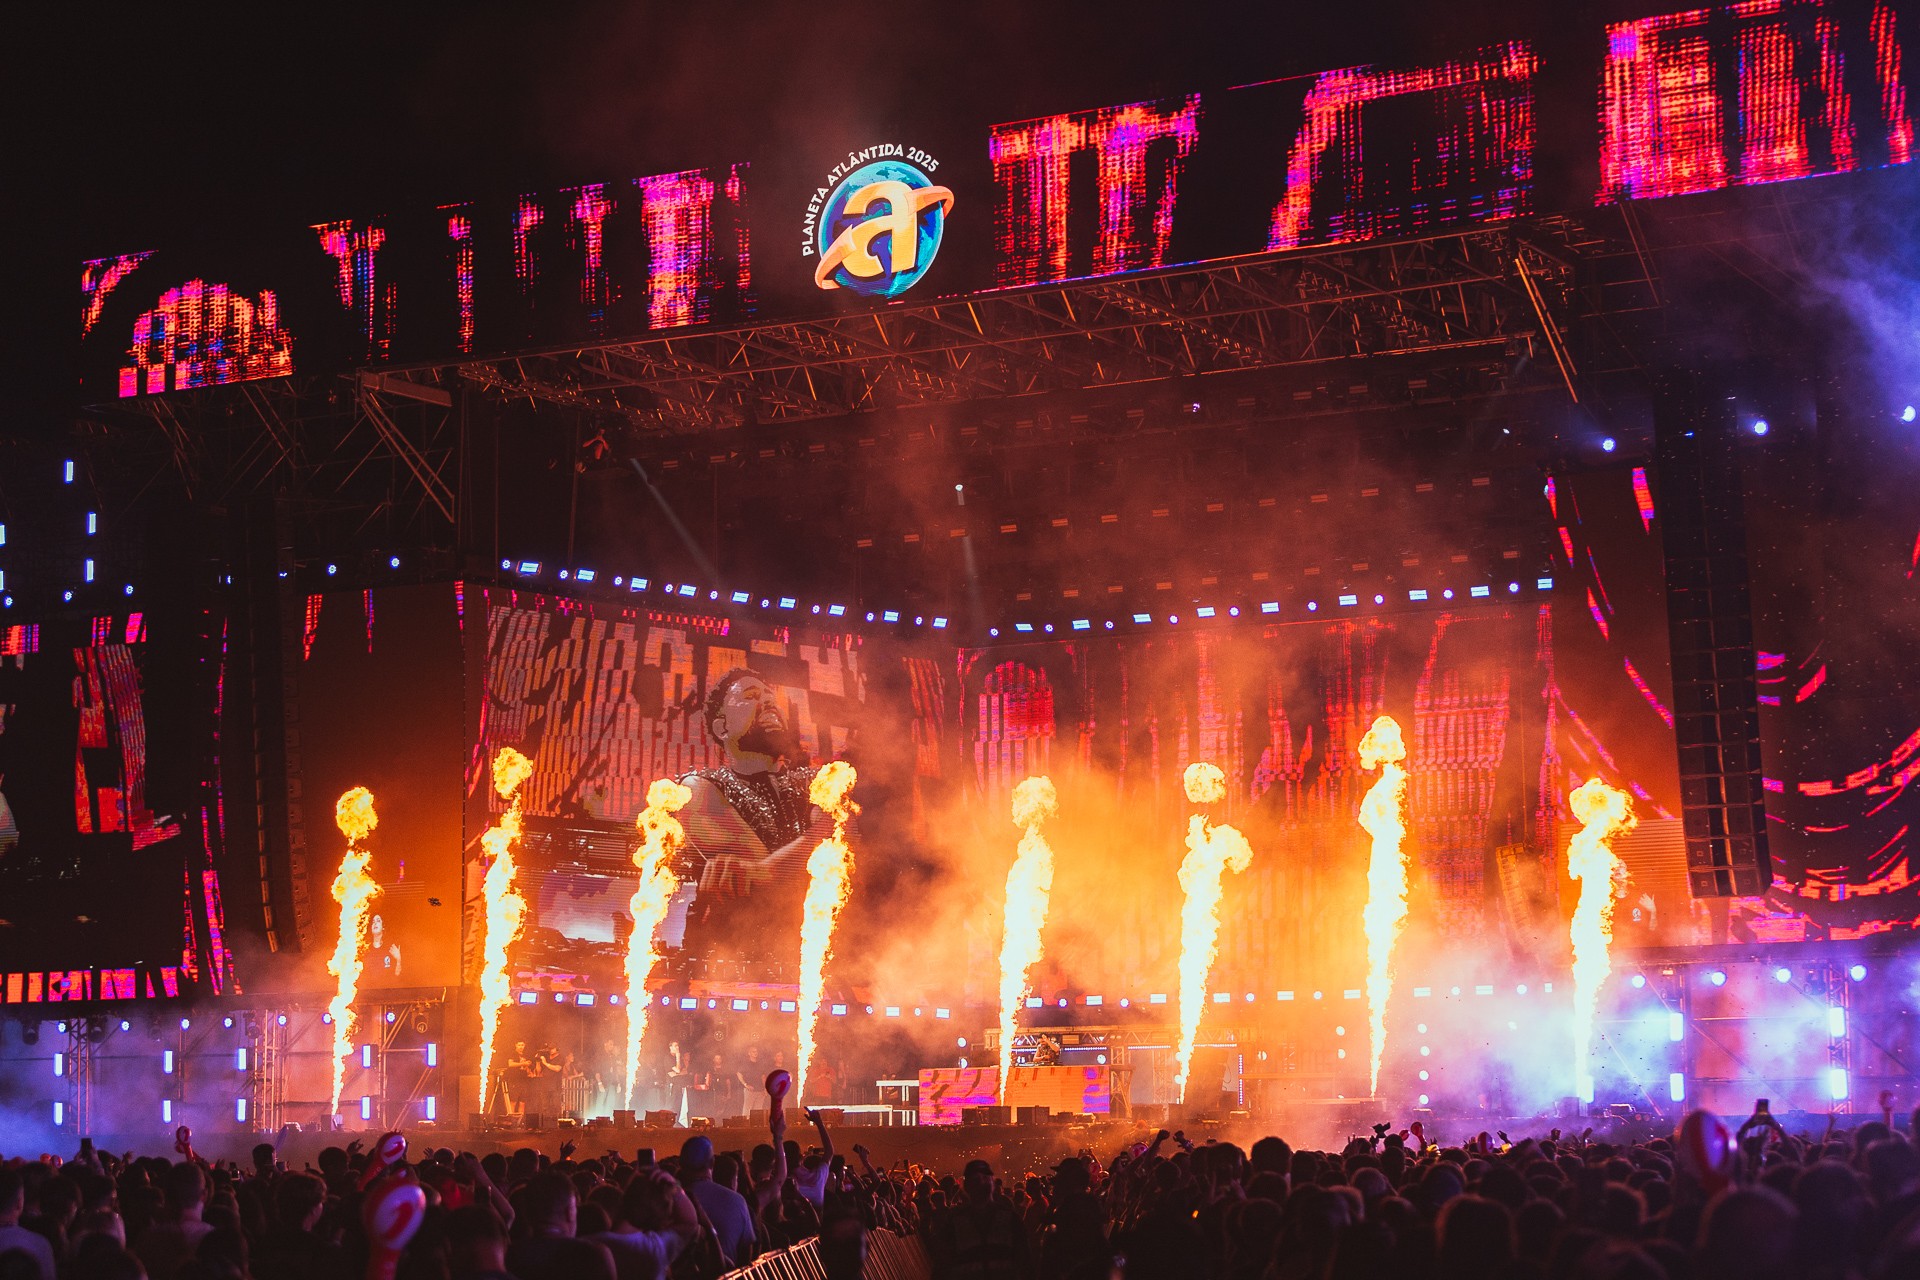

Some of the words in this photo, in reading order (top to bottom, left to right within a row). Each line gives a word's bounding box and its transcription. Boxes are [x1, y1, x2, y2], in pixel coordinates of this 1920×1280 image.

[802, 187, 829, 257] PLANETA
[827, 143, 904, 187] ATLÂNTIDA
[906, 146, 940, 173] 2025
